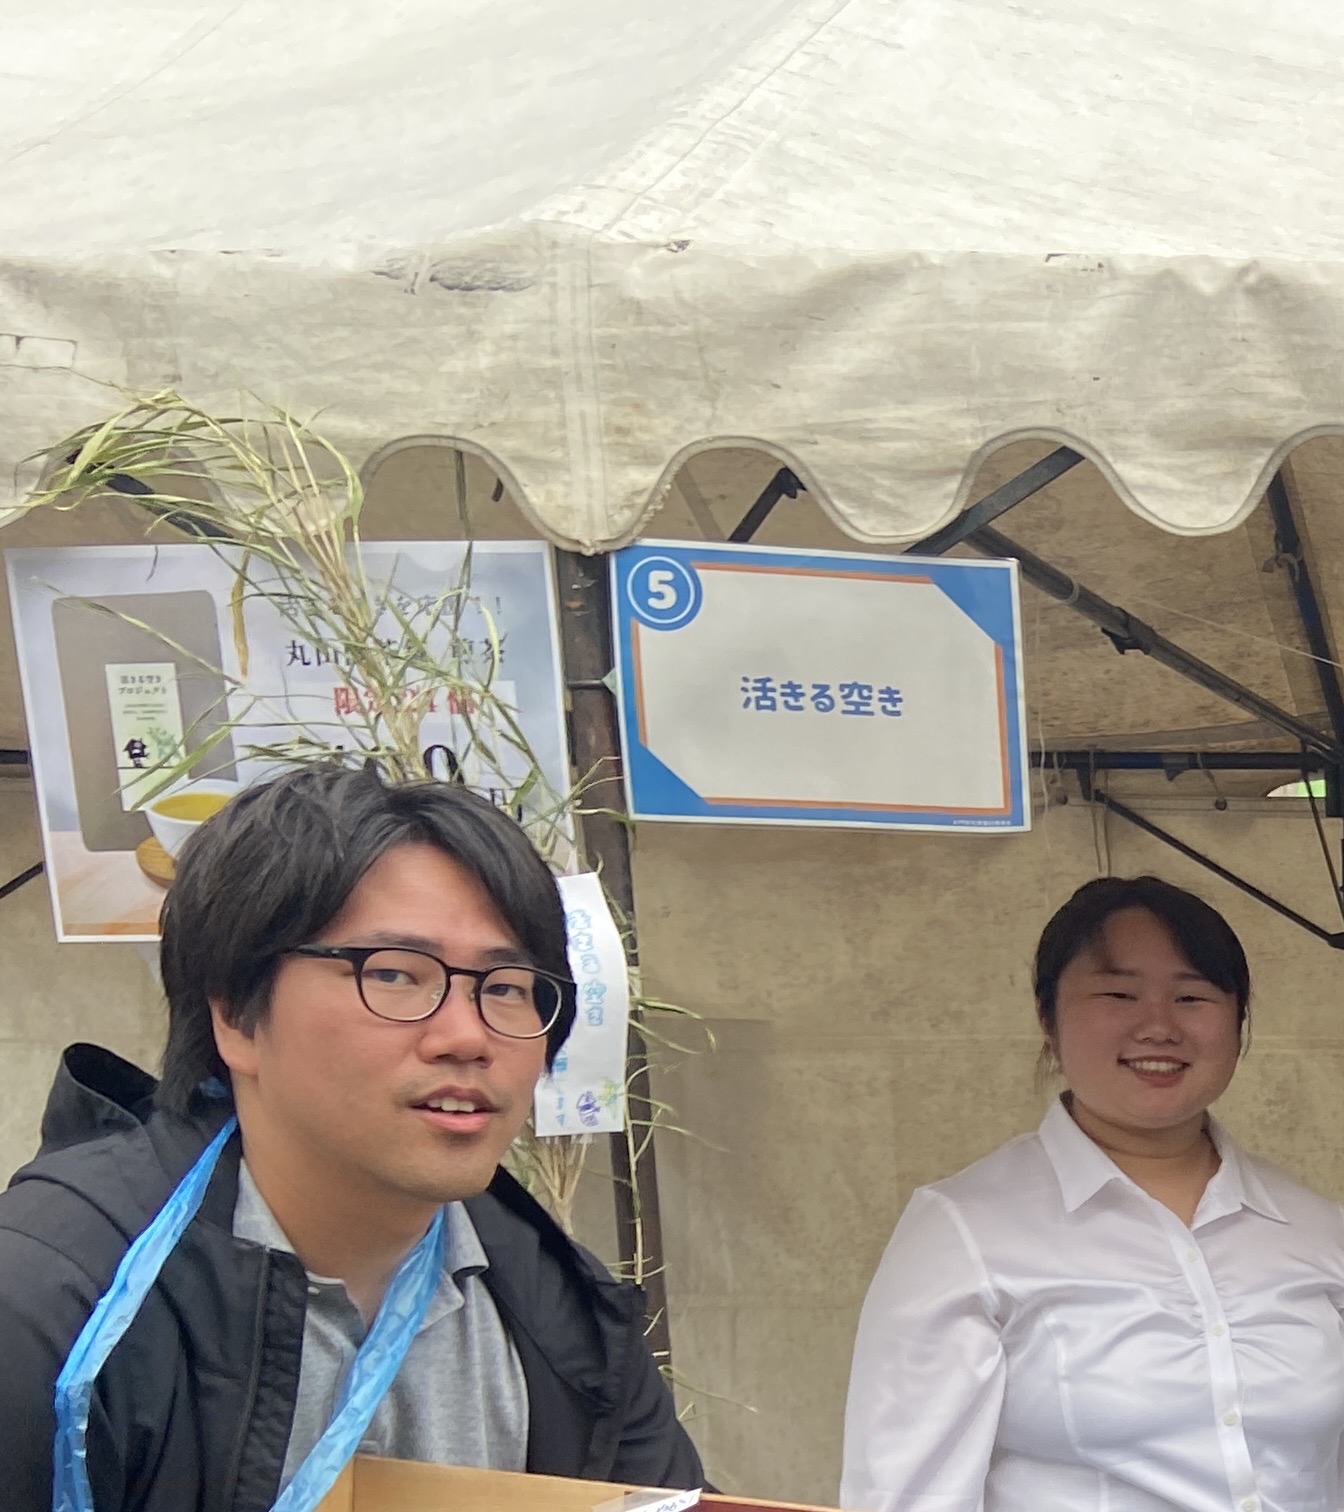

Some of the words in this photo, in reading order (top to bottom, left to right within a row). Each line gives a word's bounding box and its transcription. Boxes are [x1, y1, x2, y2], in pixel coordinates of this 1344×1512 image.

[647, 569, 678, 610] 5
[740, 675, 904, 717] 活きる空き
